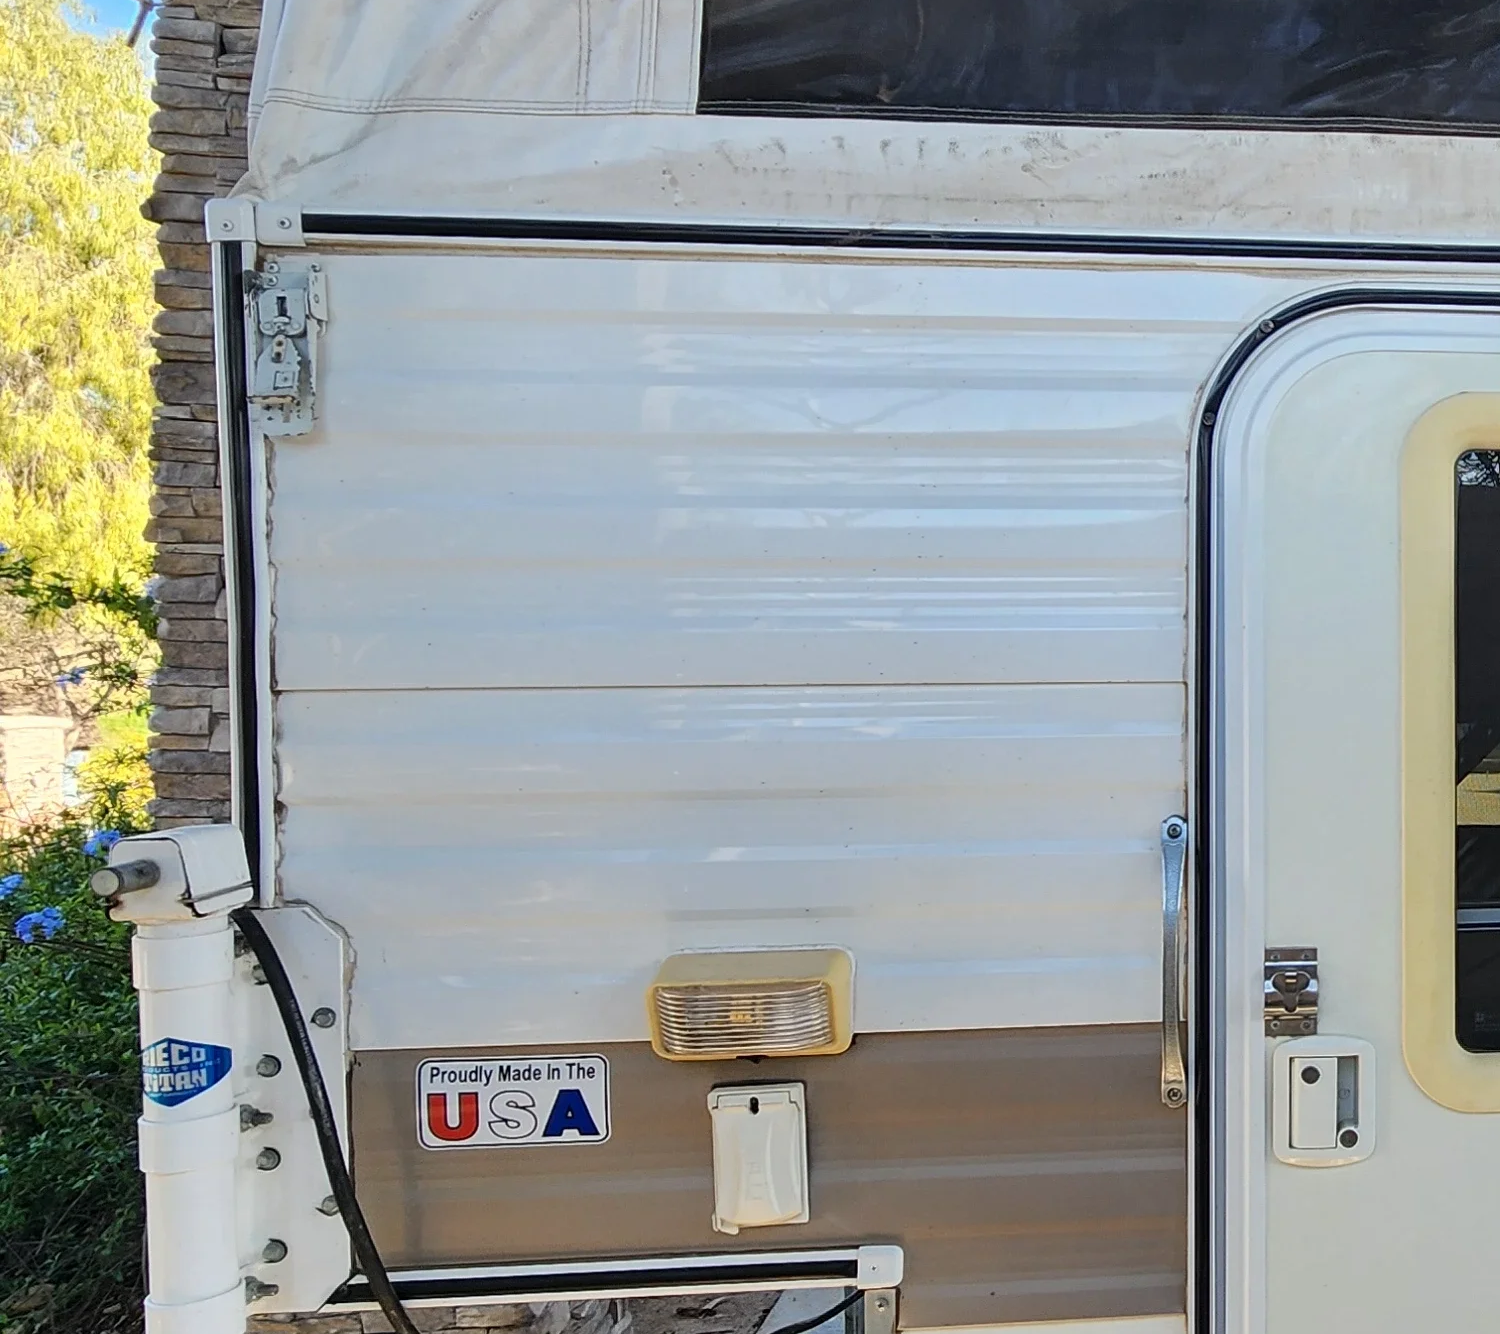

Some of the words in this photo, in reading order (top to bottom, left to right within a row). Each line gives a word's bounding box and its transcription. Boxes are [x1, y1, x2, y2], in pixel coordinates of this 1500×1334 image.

[429, 1064, 493, 1087] Proudly
[498, 1064, 542, 1083] Made
[547, 1063, 561, 1081] In
[565, 1062, 596, 1080] The
[426, 1088, 601, 1142] USA
